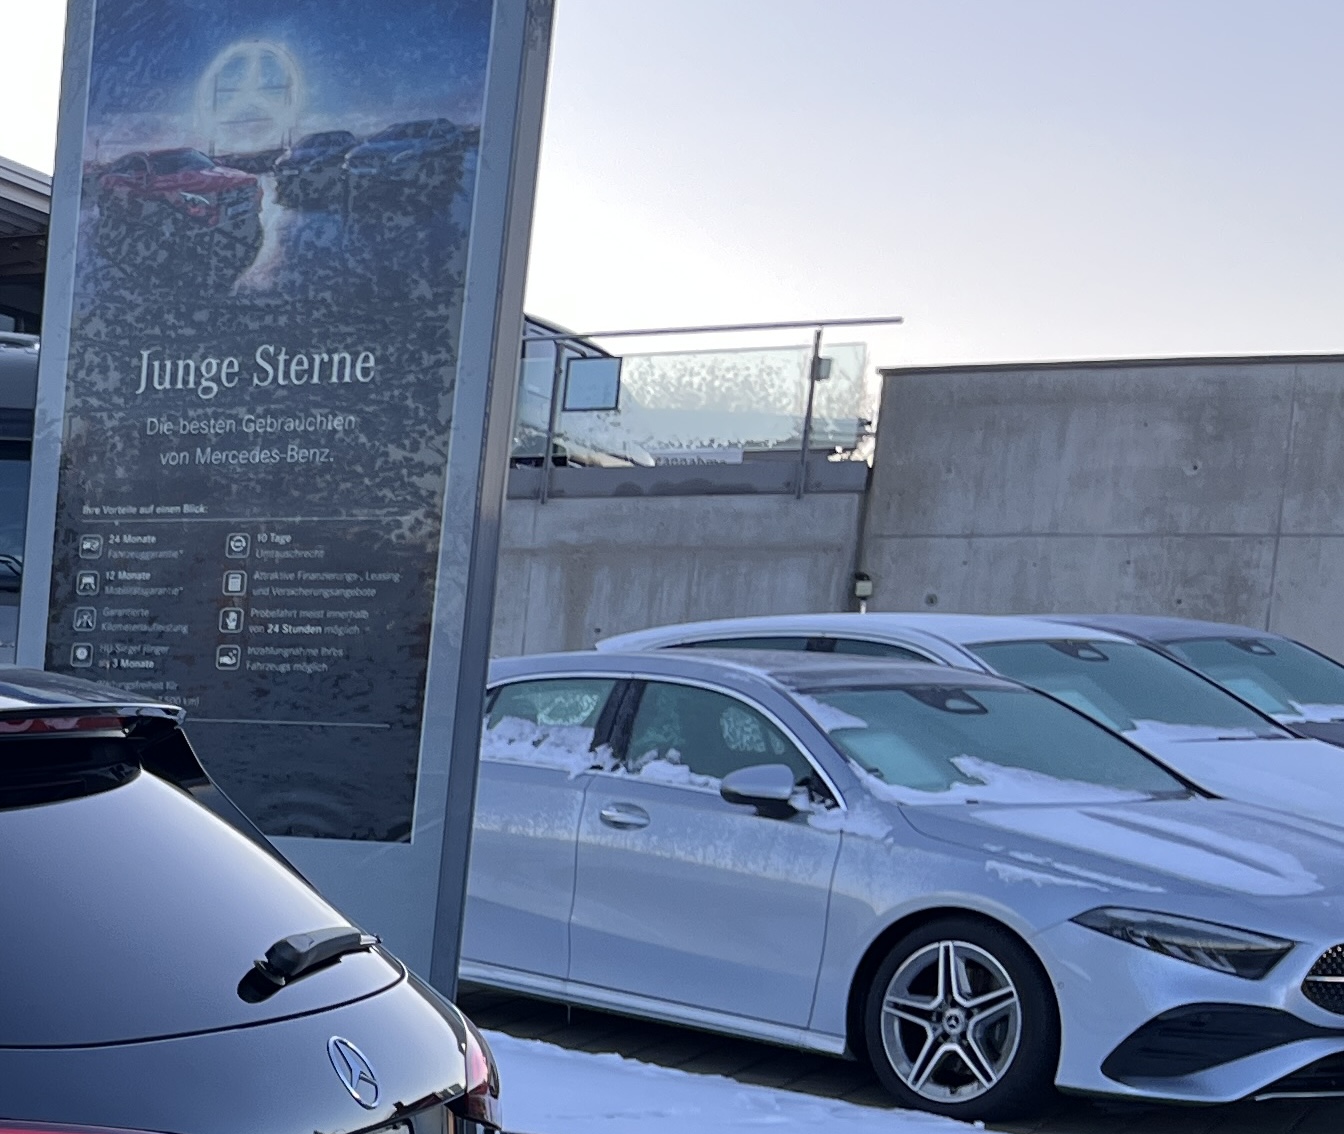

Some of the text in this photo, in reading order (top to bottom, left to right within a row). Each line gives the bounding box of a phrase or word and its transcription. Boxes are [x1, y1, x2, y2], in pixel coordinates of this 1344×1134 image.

[136, 344, 376, 399] Junge Sterne
[146, 414, 356, 435] Die besten Gebrauchten
[160, 444, 334, 466] von Mercedes-Benz.
[139, 504, 154, 515] auf
[156, 504, 181, 515] einen
[108, 534, 156, 544] 24 Monate
[270, 532, 292, 545] Tage
[118, 570, 151, 580] Monate
[267, 623, 280, 634] 24
[282, 623, 322, 634] Stunden
[112, 659, 118, 669] 3
[120, 659, 154, 669] Monate
